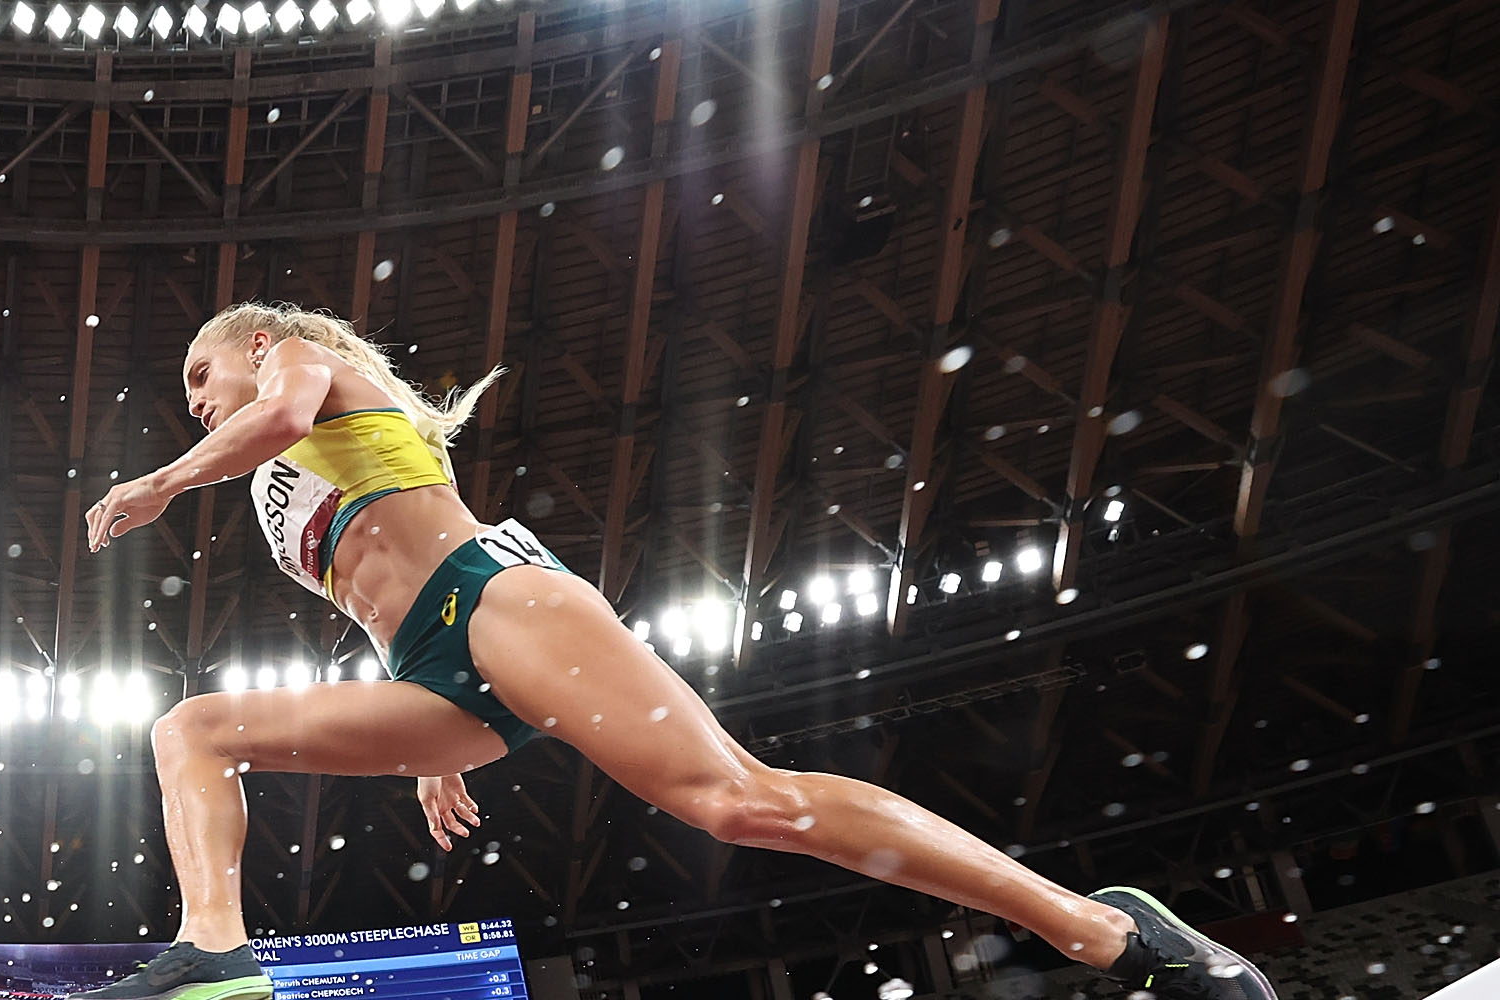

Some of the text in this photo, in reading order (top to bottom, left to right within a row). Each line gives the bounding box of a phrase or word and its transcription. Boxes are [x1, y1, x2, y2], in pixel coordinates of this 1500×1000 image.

[480, 529, 546, 564] 14
[461, 919, 513, 932] WR 8:44.32
[248, 922, 450, 950] OMEN'S 3000M STEEPLECHASE
[464, 934, 477, 942] OR
[252, 950, 281, 962] NAL
[456, 949, 501, 961] TIME GAP
[274, 975, 346, 988] Peruth CHEMUTAI
[276, 973, 508, 1000] Beatrice CHEPKOECH +0.3
[491, 986, 510, 996] +0.3
